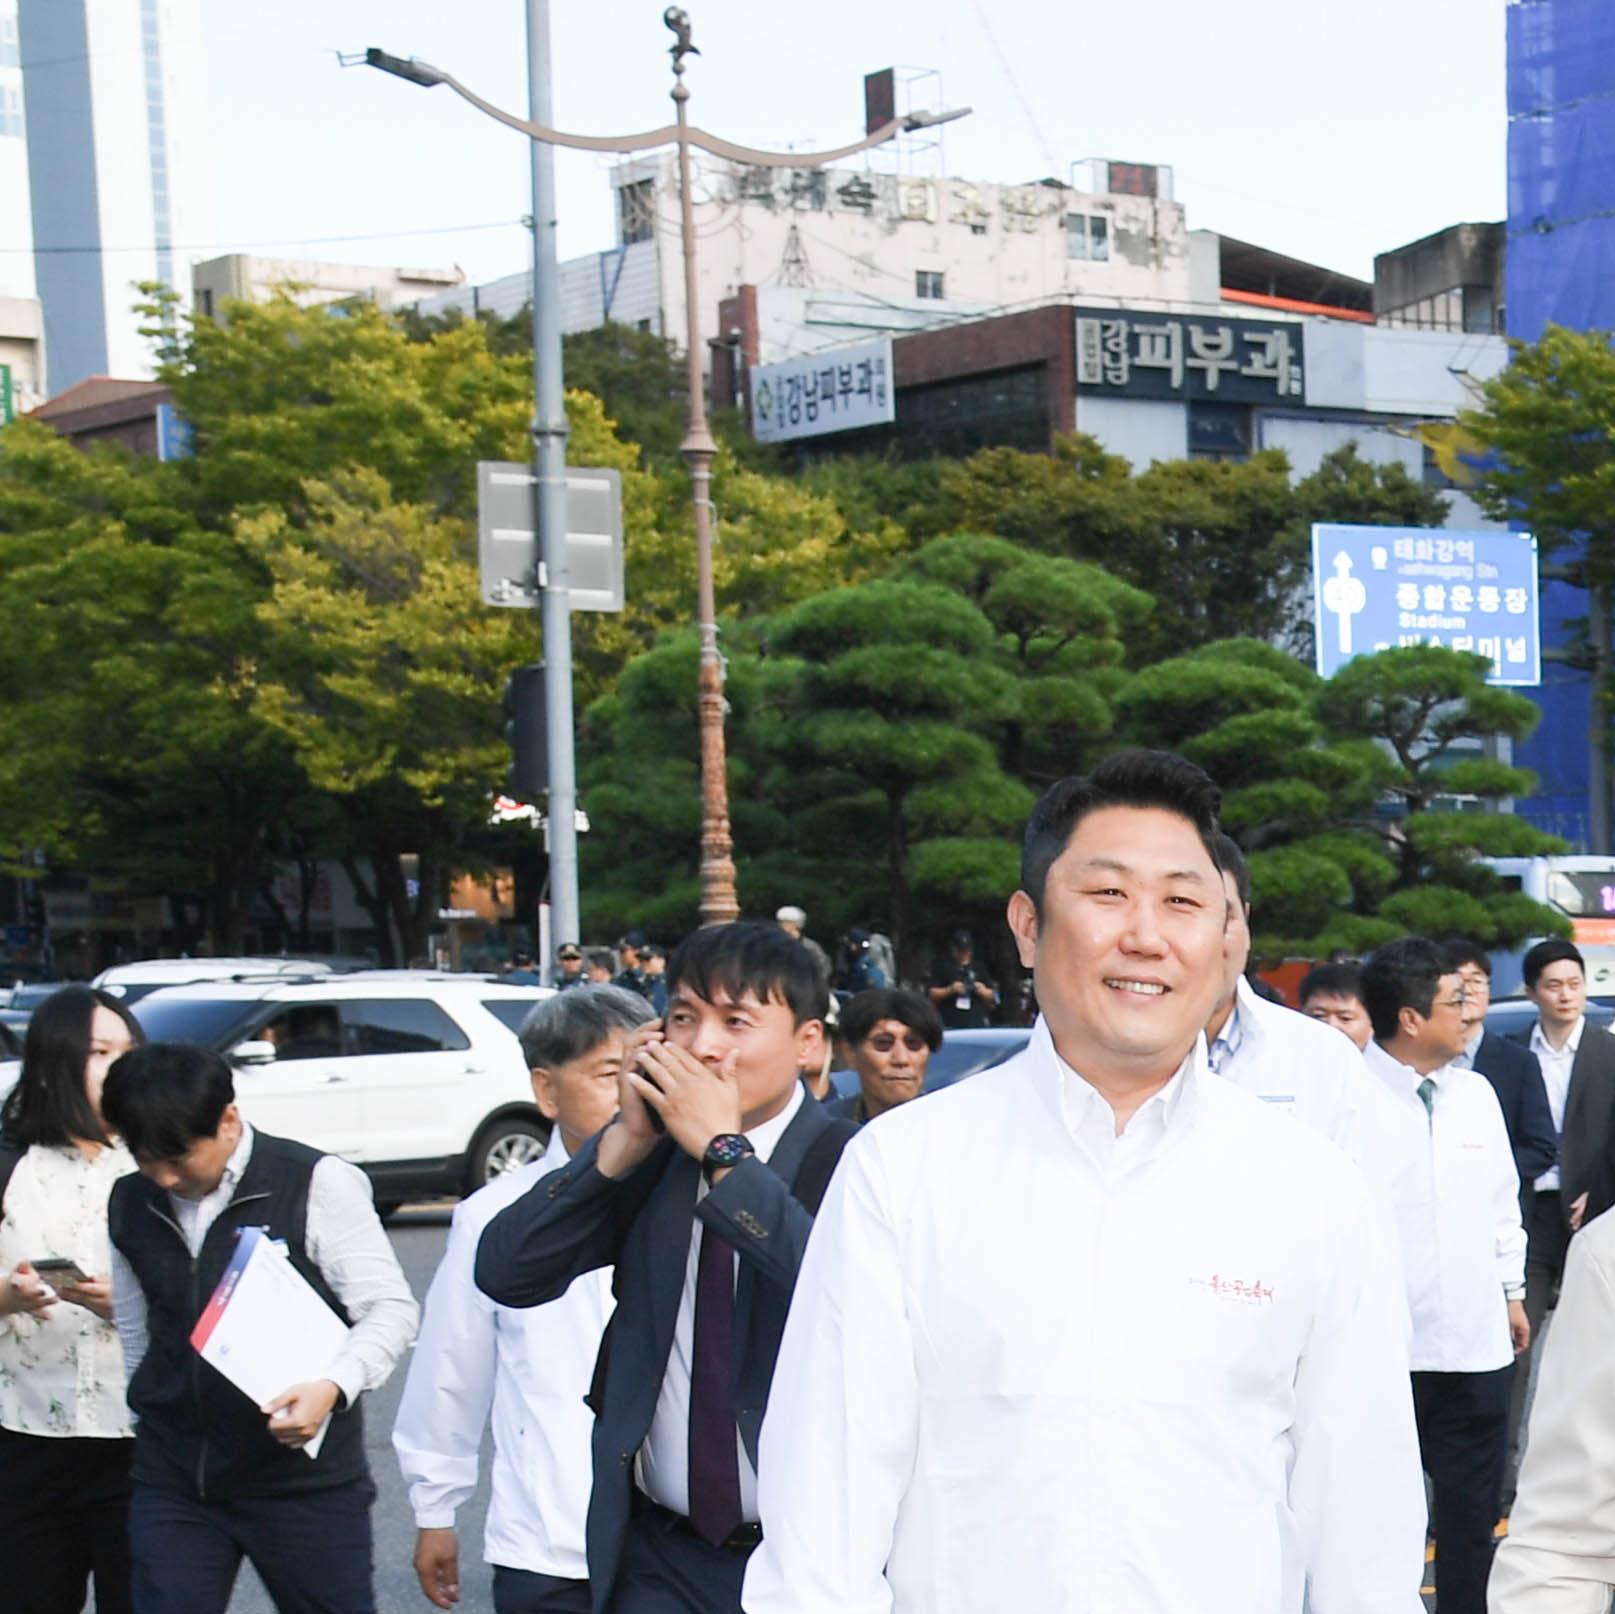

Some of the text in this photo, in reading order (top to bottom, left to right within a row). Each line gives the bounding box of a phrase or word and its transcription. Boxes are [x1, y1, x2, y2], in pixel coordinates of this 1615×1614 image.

[1100, 318, 1131, 386] 강남
[1132, 321, 1296, 396] 피부과
[785, 357, 873, 425] 강남피부과
[1393, 537, 1475, 563] 태화강역
[1396, 582, 1528, 614] 종합운동장
[1399, 612, 1467, 630] Stadium
